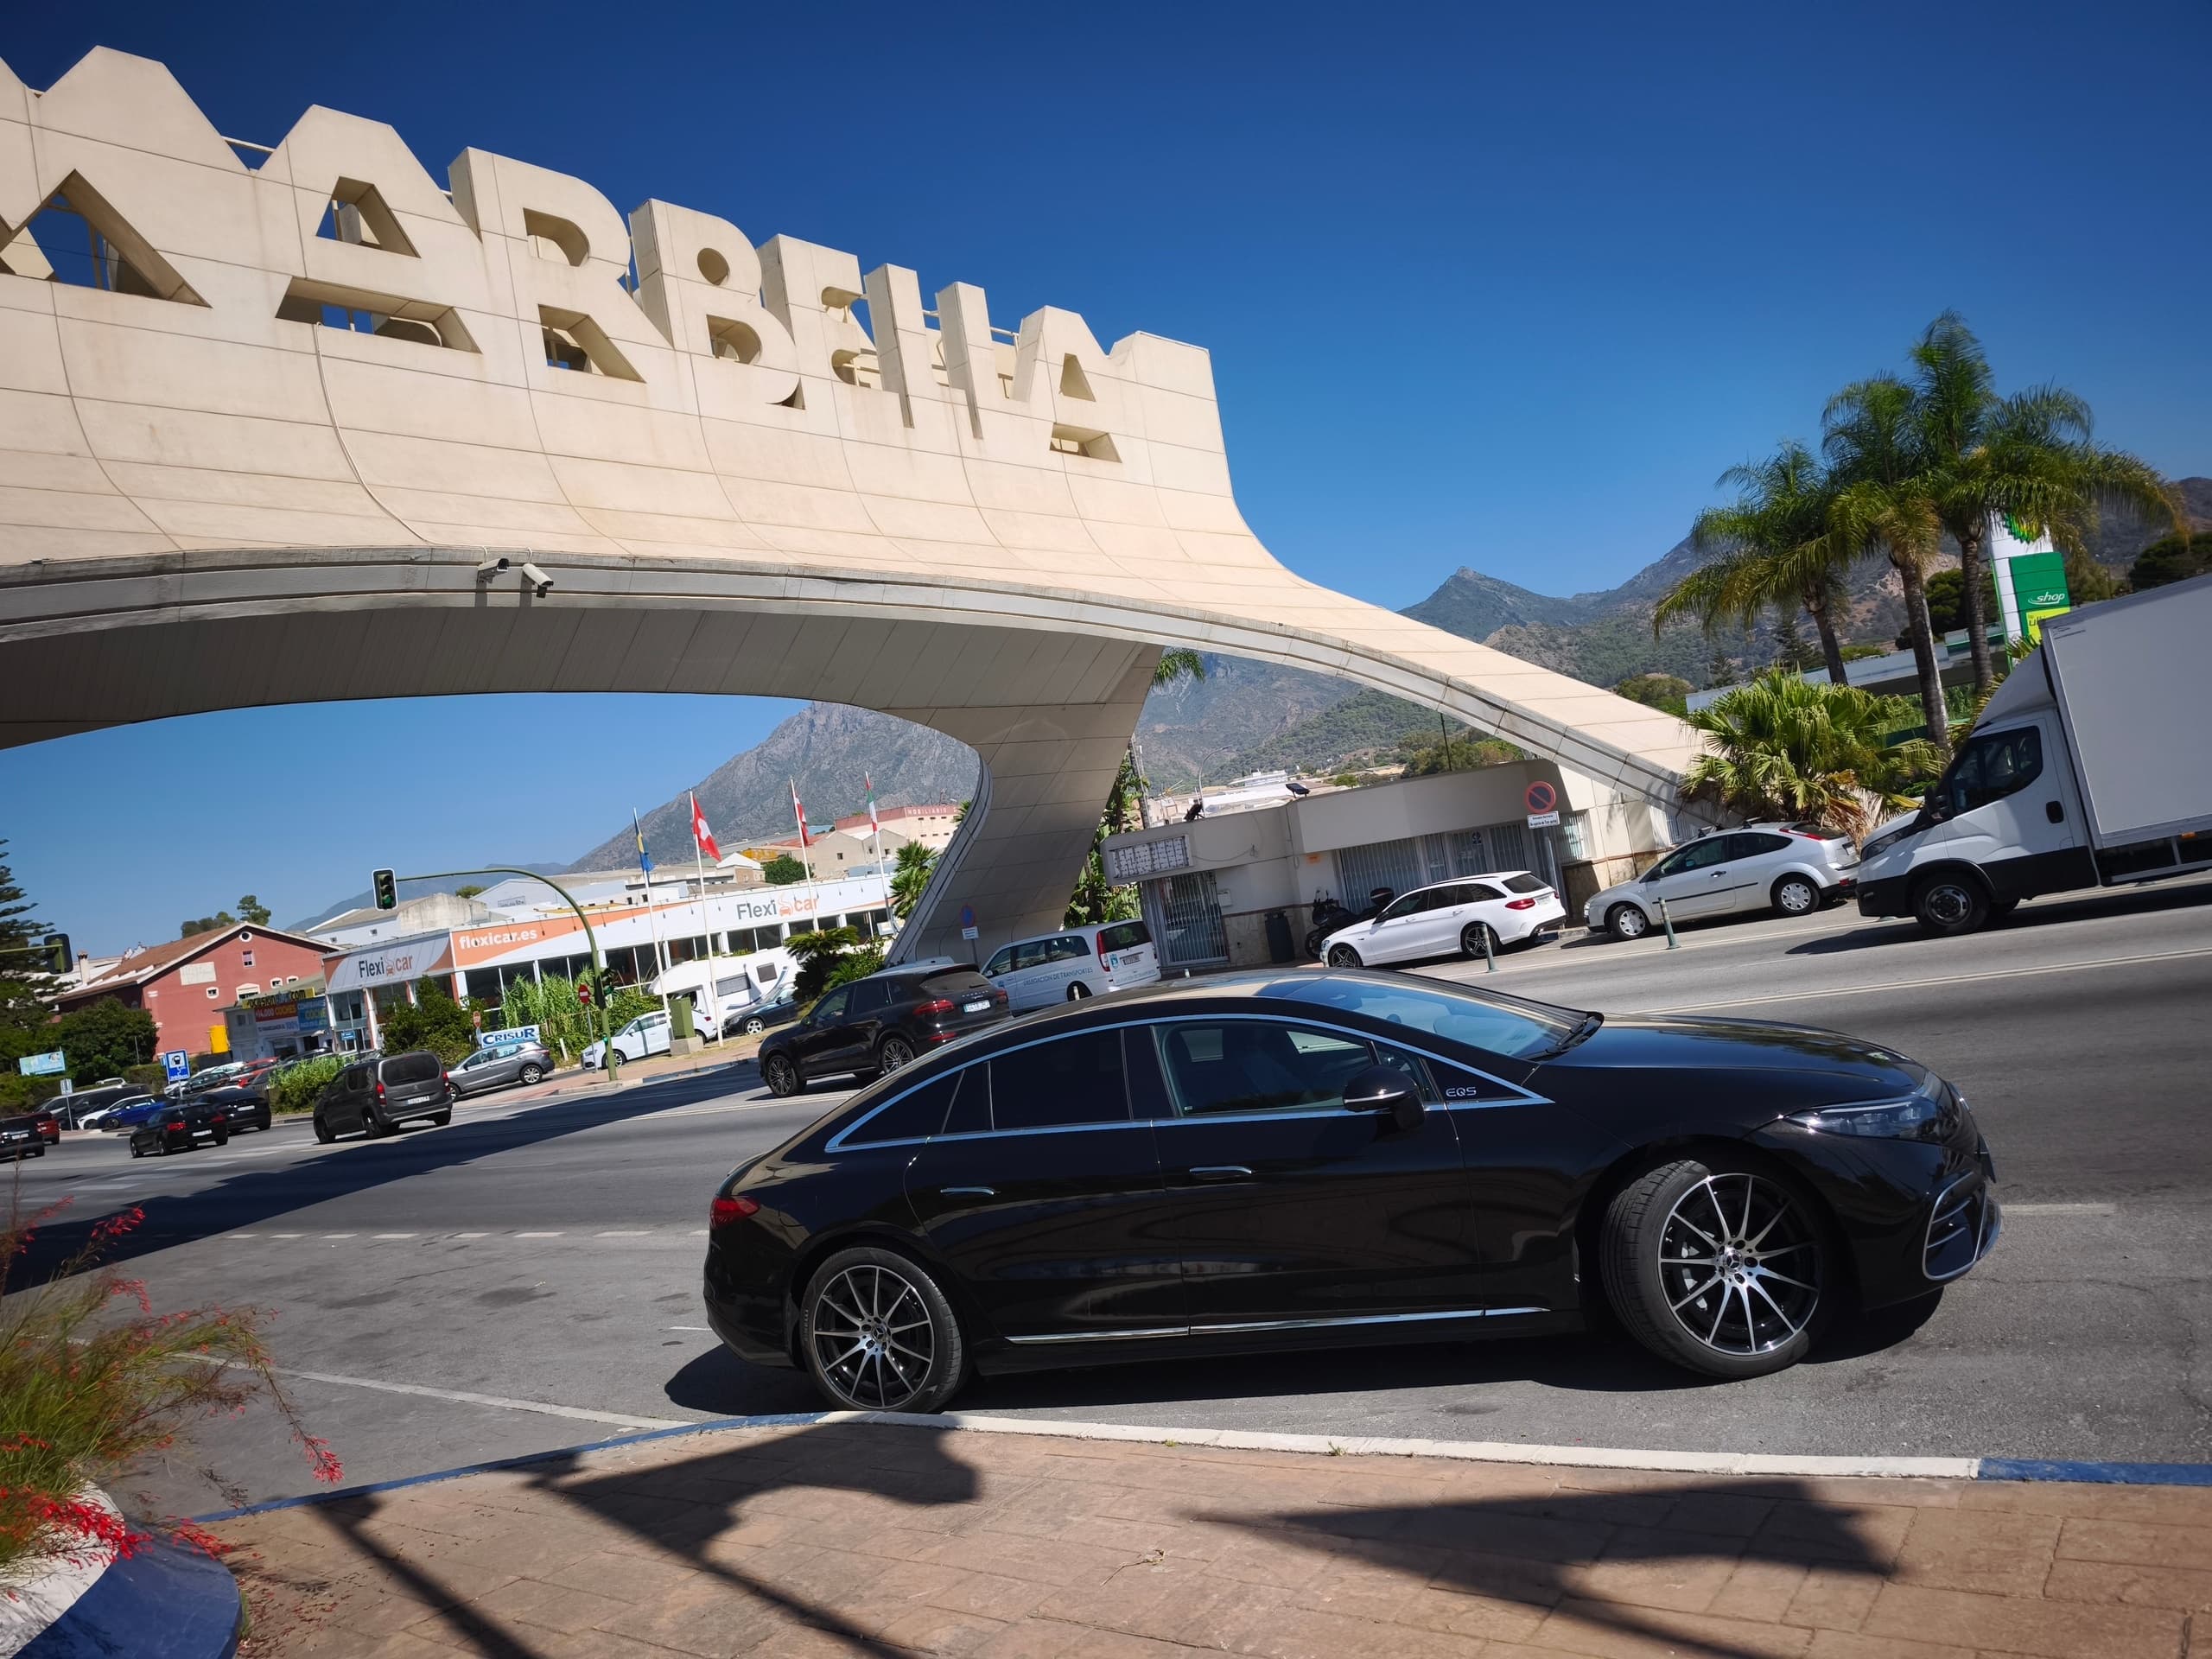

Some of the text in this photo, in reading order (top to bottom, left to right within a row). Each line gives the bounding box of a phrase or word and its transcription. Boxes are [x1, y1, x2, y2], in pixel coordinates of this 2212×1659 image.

[2037, 592, 2065, 604] shop
[483, 1028, 536, 1045] CRISUR
[1446, 1086, 1477, 1097] EQS
